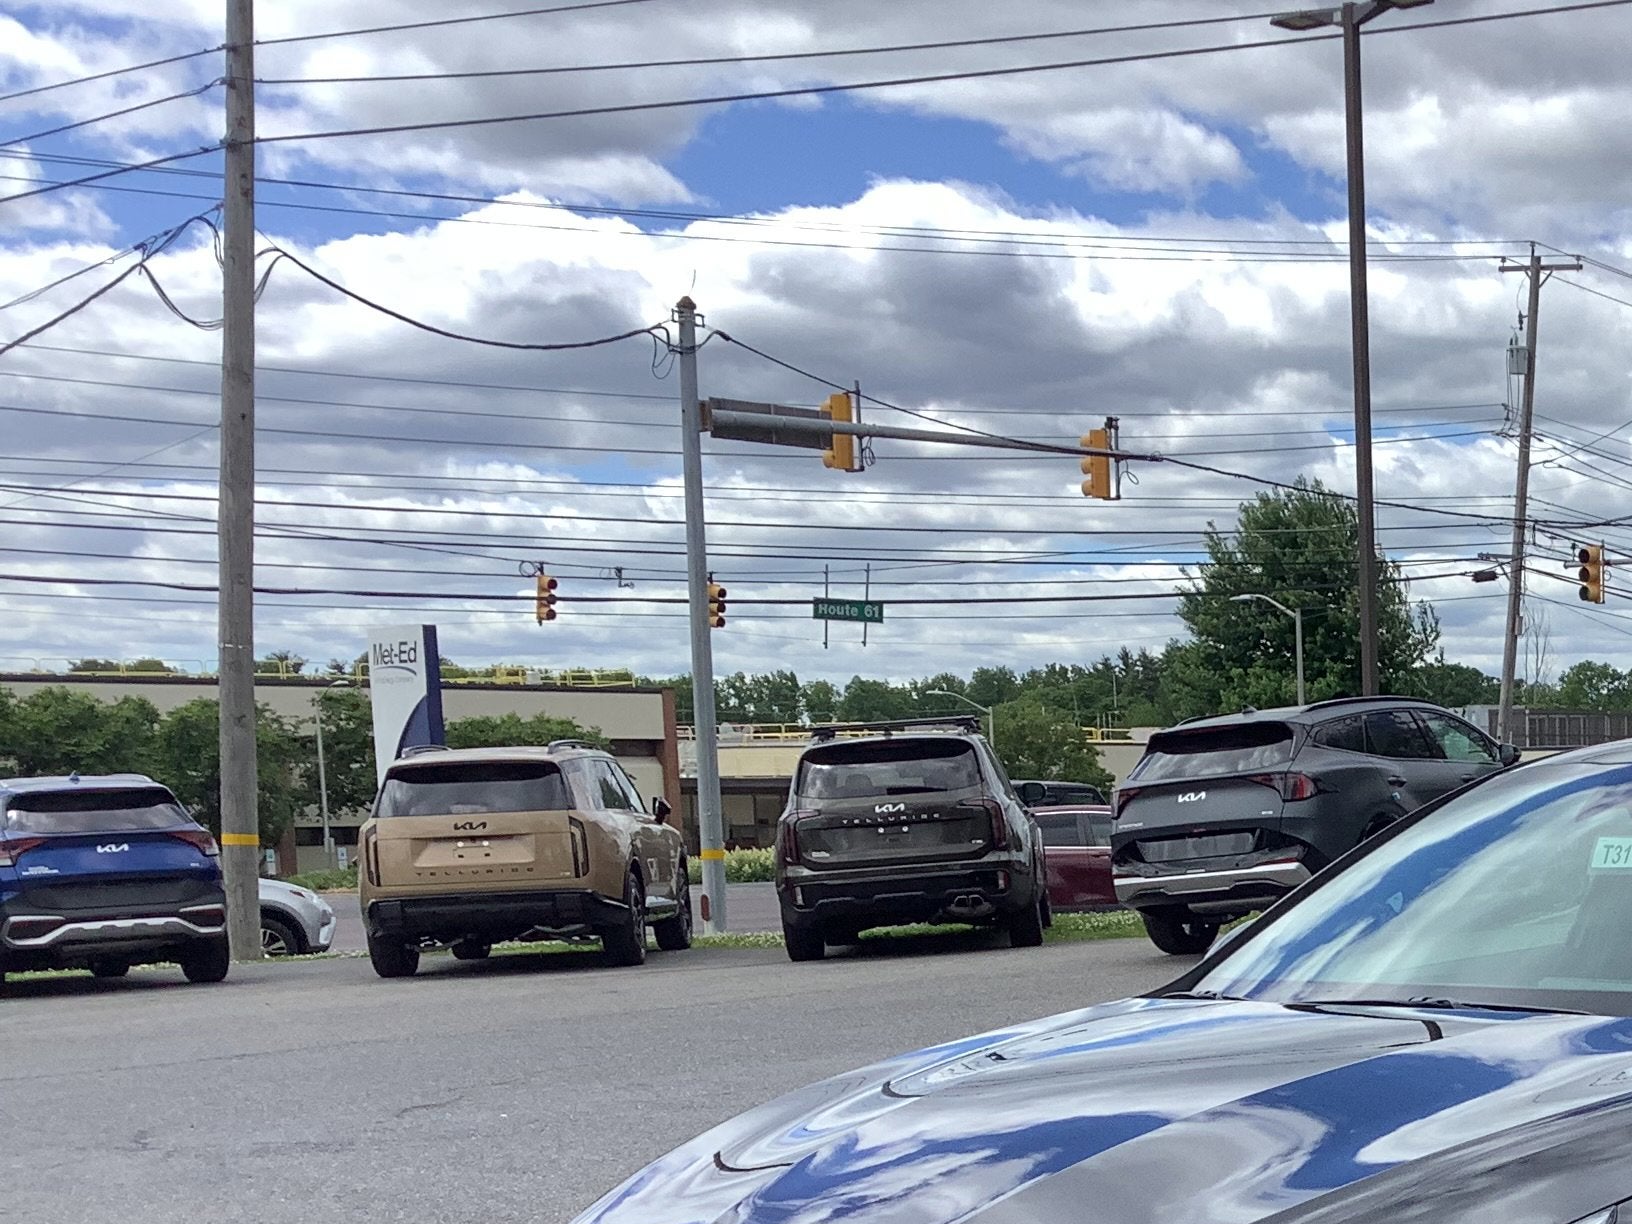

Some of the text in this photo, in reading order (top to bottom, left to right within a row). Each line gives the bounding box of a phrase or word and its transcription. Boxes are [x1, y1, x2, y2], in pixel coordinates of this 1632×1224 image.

[818, 603, 879, 618] Route 61
[373, 641, 417, 666] Met-Ed
